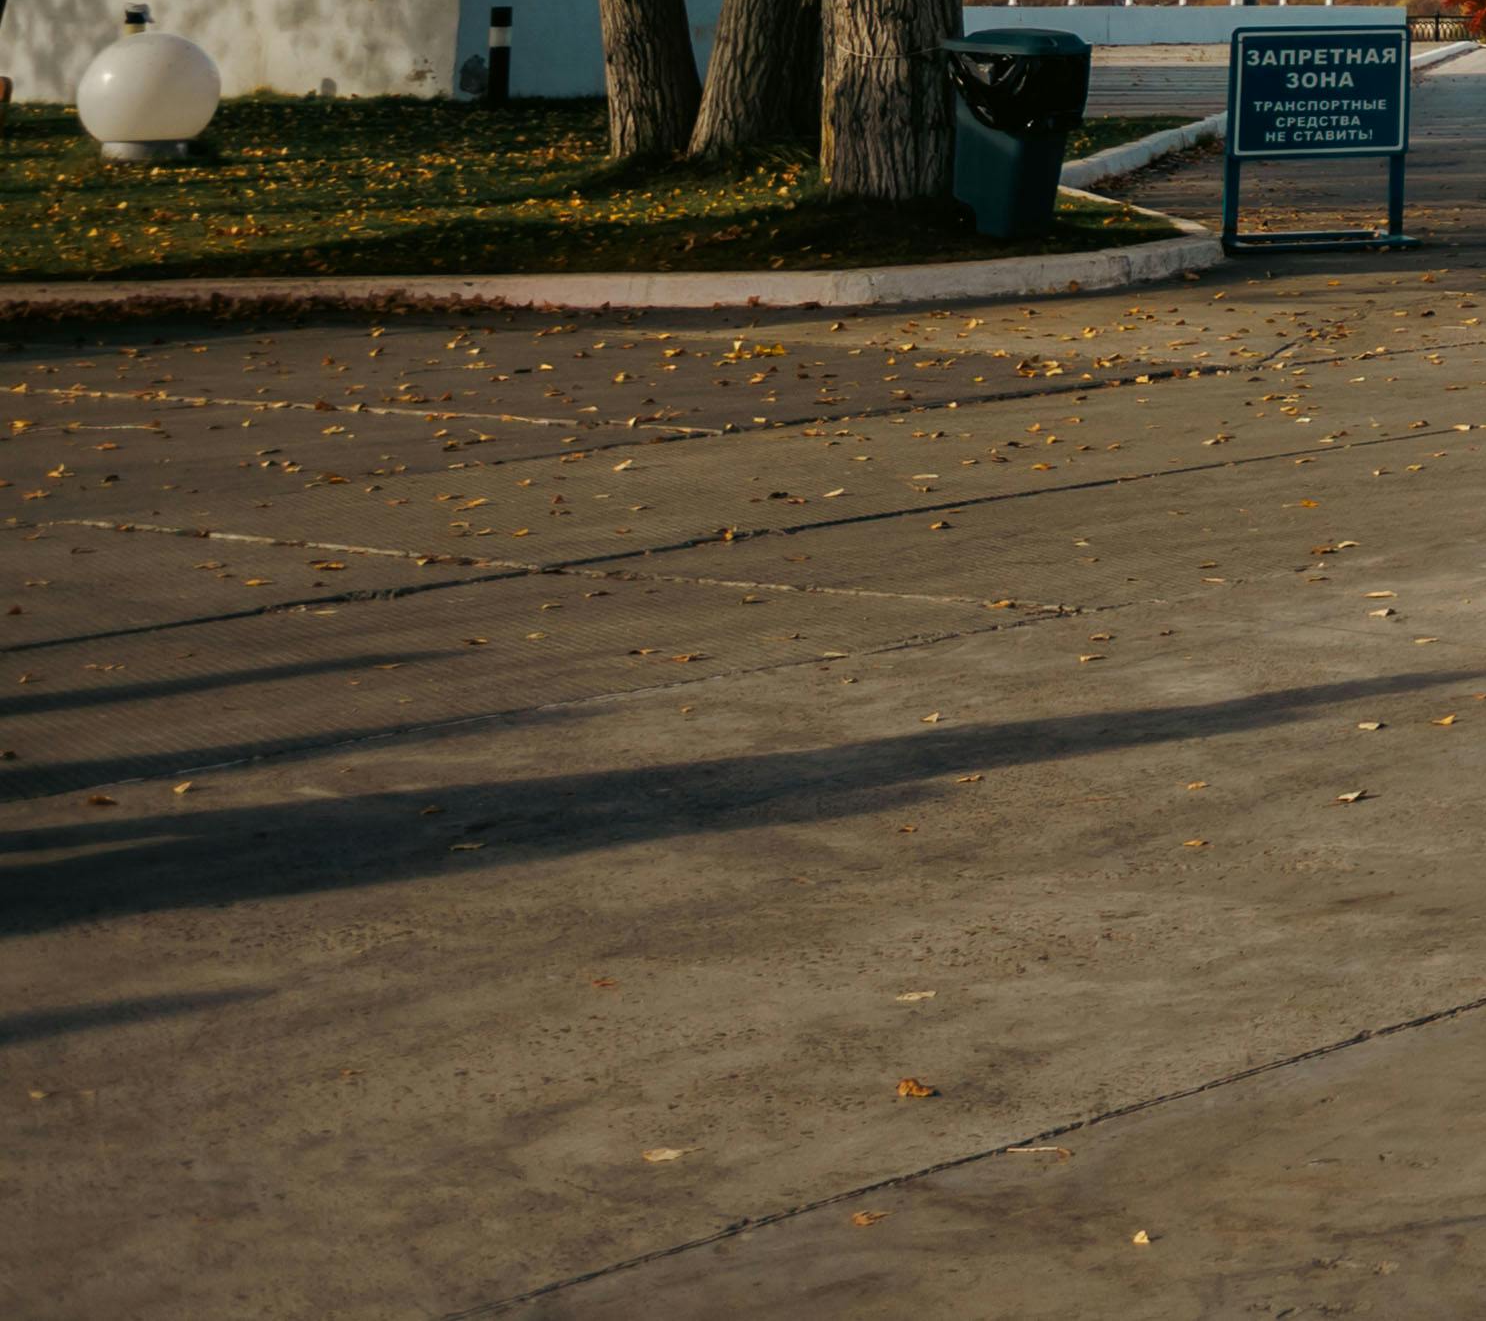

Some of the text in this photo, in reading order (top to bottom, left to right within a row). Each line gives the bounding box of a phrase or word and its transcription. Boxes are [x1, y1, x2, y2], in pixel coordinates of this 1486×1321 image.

[1246, 48, 1397, 66] ЗАПРЕТНАЯ
[1286, 72, 1354, 89] ЗОНА
[1254, 99, 1387, 112] ТРАНСПОРТНЫЕ
[1276, 116, 1361, 128] СРЕДСТВА
[1265, 129, 1373, 142] НЕ СТАВИТЬ!
